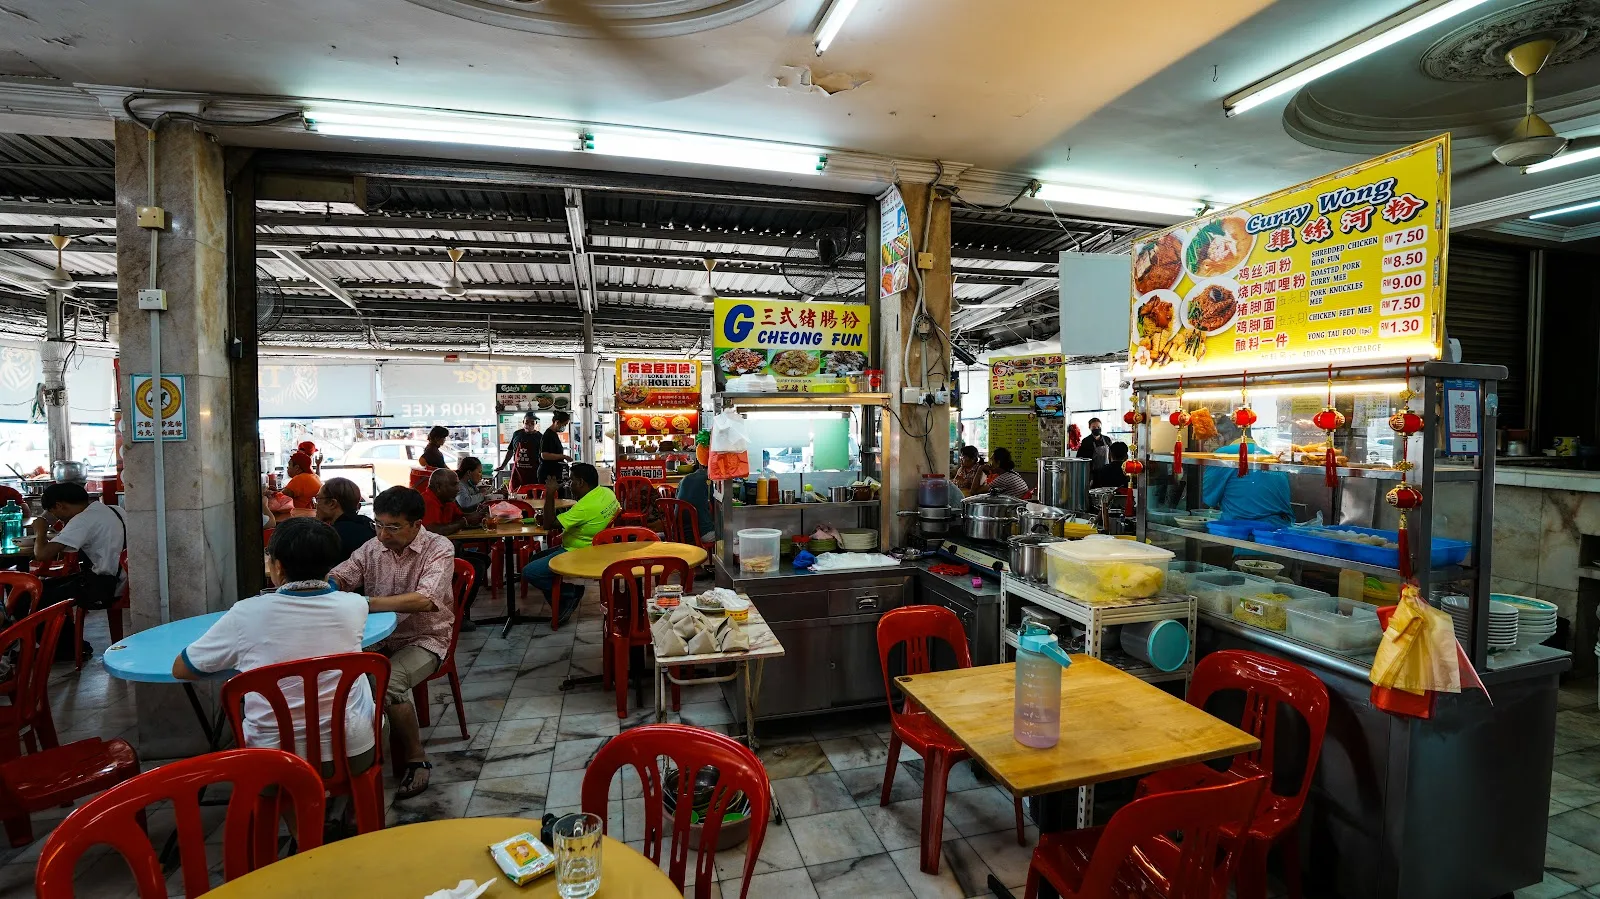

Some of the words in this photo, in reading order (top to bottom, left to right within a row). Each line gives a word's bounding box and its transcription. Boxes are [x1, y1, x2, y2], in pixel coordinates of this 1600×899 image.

[1246, 204, 1310, 233] Curry
[1319, 177, 1395, 214] Wong
[1267, 196, 1424, 248] 雞絲河粉
[1384, 235, 1393, 244] RM
[1395, 228, 1424, 246] 7.50
[1311, 244, 1345, 258] SHREDDED
[1347, 237, 1378, 250] CHICKEN
[1311, 256, 1325, 266] HOR
[1327, 254, 1340, 264] FUN
[1383, 257, 1393, 266] RM
[1393, 251, 1423, 268] 8.50
[1238, 257, 1292, 280] 鸡丝河粉
[1310, 266, 1340, 278] ROASTED
[1342, 261, 1361, 271] PORK
[1237, 273, 1306, 299] 烧肉咖哩粉
[1310, 276, 1331, 287] CURRY
[1333, 273, 1347, 282] MEE
[1383, 279, 1391, 288] RM
[1392, 274, 1422, 290] 9.00
[1309, 288, 1327, 298] PORK
[1329, 282, 1363, 294] KNUCKLES
[1236, 297, 1276, 317] 猪脚面
[1309, 297, 1323, 306] MEE
[1381, 300, 1391, 309] RM
[1391, 296, 1421, 312] 7.50
[760, 306, 861, 329] 三式豬腸粉
[1308, 311, 1336, 321] CHICKEN
[1339, 308, 1355, 317] FEET
[1357, 306, 1372, 314] MEE
[723, 304, 755, 343] G
[1236, 316, 1275, 333] 鸡脚面
[1380, 322, 1389, 330] RM
[1390, 319, 1419, 333] 1.30
[757, 330, 823, 346] CHEONG
[831, 333, 863, 347] FUN
[1235, 333, 1288, 352] 酿料一件
[1308, 331, 1325, 340] YONG
[1328, 329, 1340, 338] TAU
[1342, 328, 1357, 336] FOO
[1329, 346, 1351, 356] EXTRA
[1352, 343, 1382, 353] CHARGE
[647, 379, 670, 387] HOR
[671, 379, 691, 387] HEE
